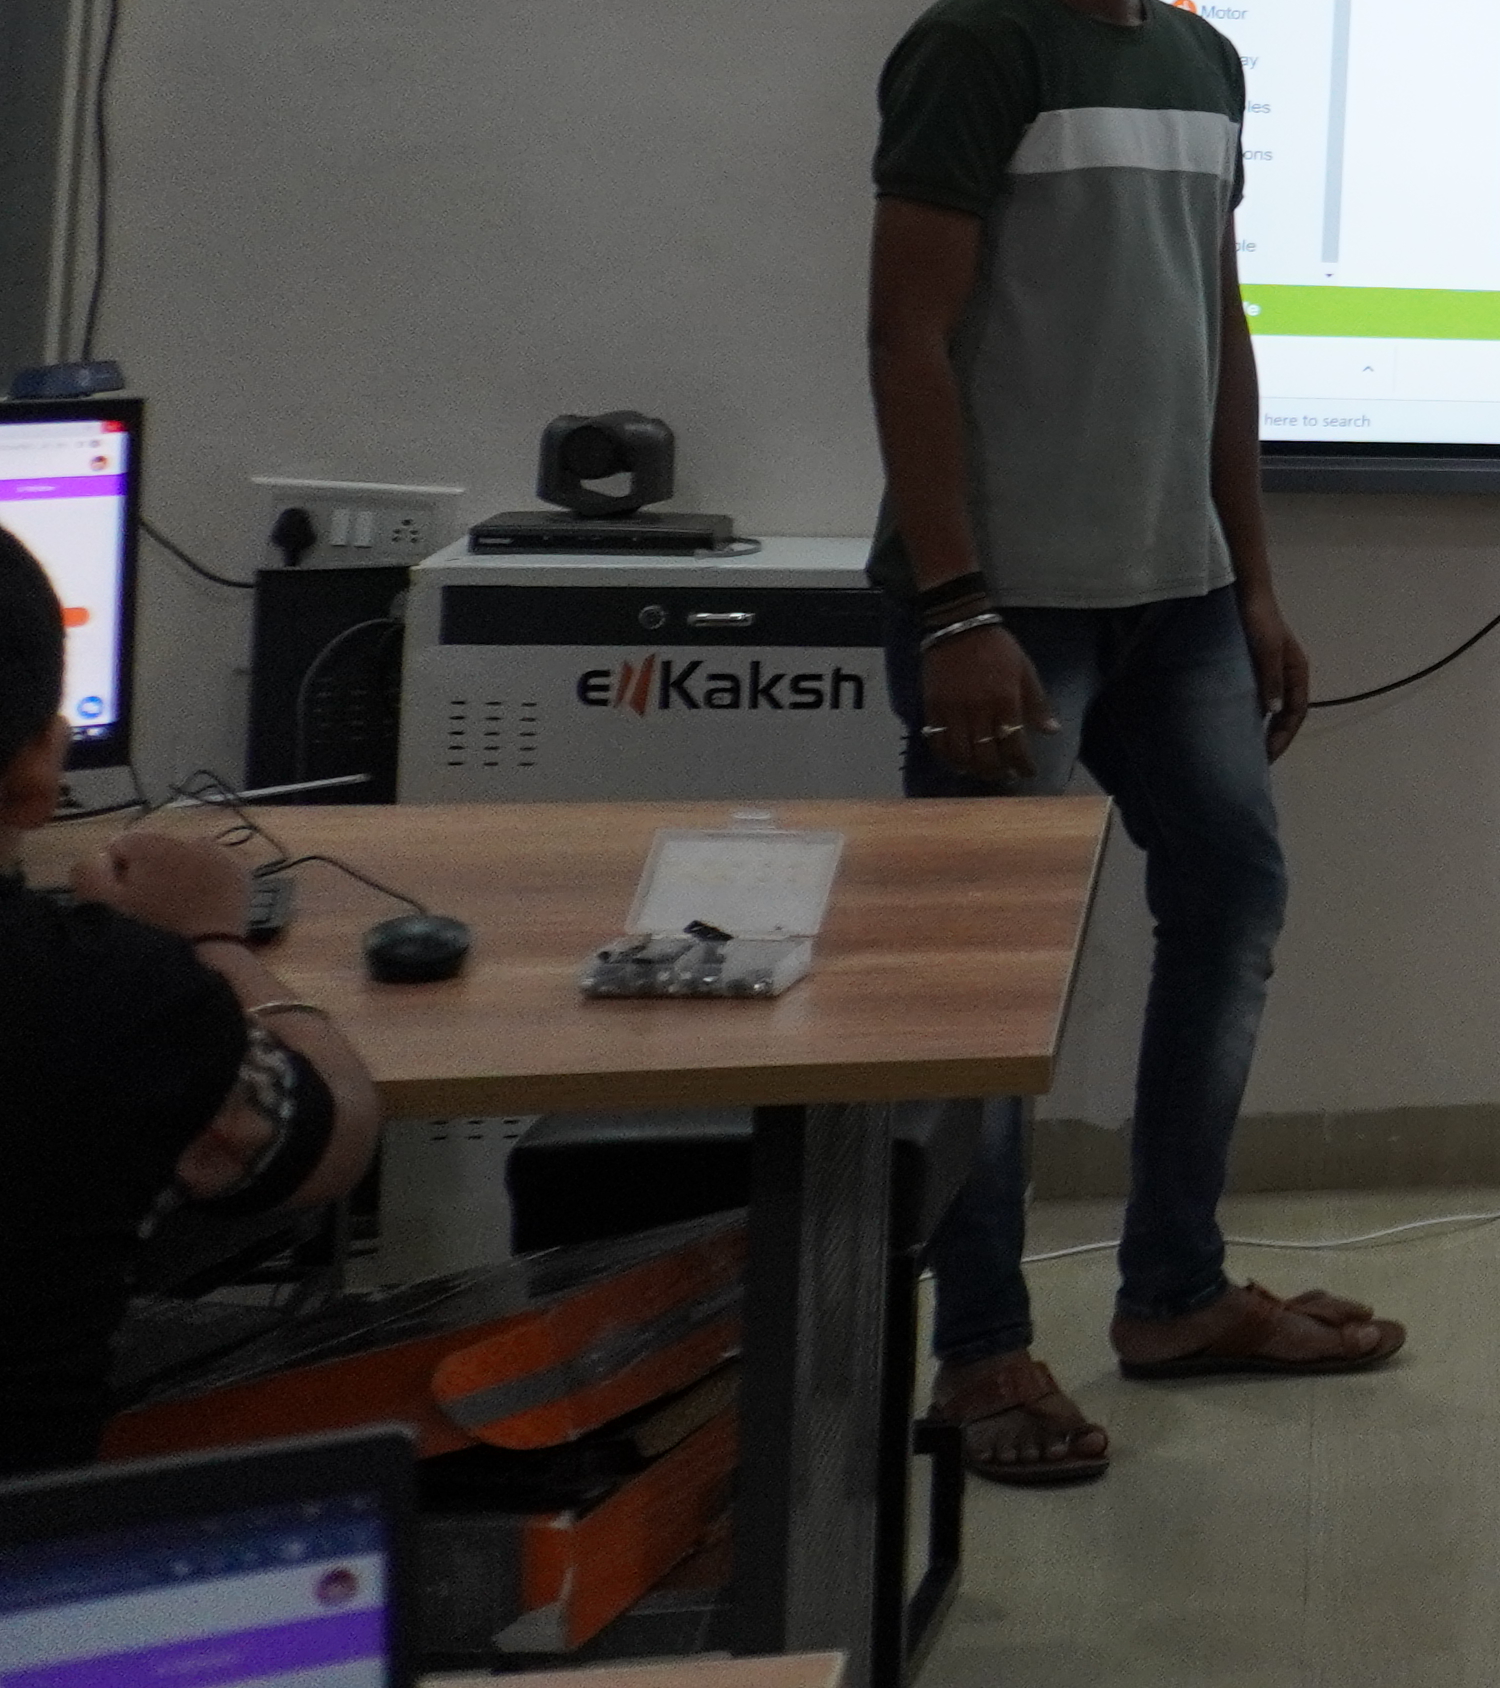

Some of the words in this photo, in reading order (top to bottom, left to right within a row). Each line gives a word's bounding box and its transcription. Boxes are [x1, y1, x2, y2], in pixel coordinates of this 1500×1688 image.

[1200, 5, 1247, 20] Motor
[1264, 413, 1298, 426] here
[1302, 415, 1318, 427] to
[1322, 414, 1371, 428] search
